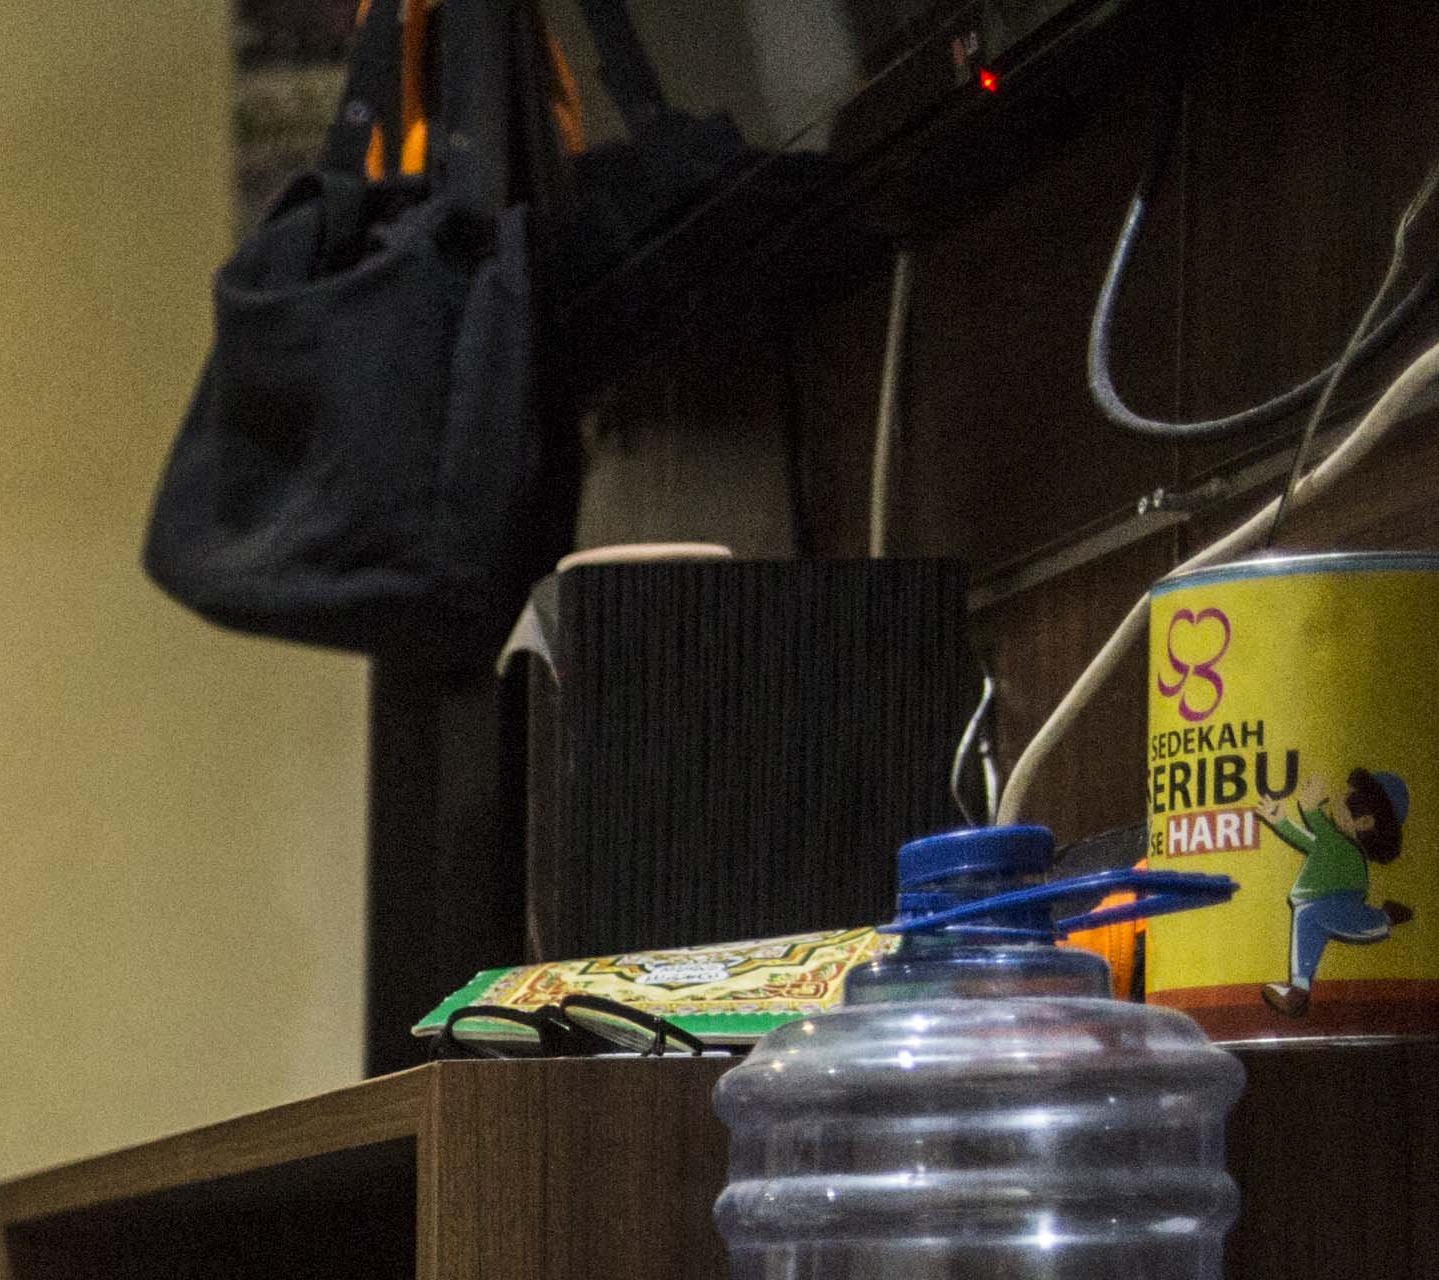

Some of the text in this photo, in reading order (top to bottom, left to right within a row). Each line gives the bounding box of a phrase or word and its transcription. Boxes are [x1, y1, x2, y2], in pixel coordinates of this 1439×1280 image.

[1151, 719, 1264, 762] SEDEKAH
[1148, 749, 1299, 815] ERIBU
[1168, 811, 1255, 855] HARI
